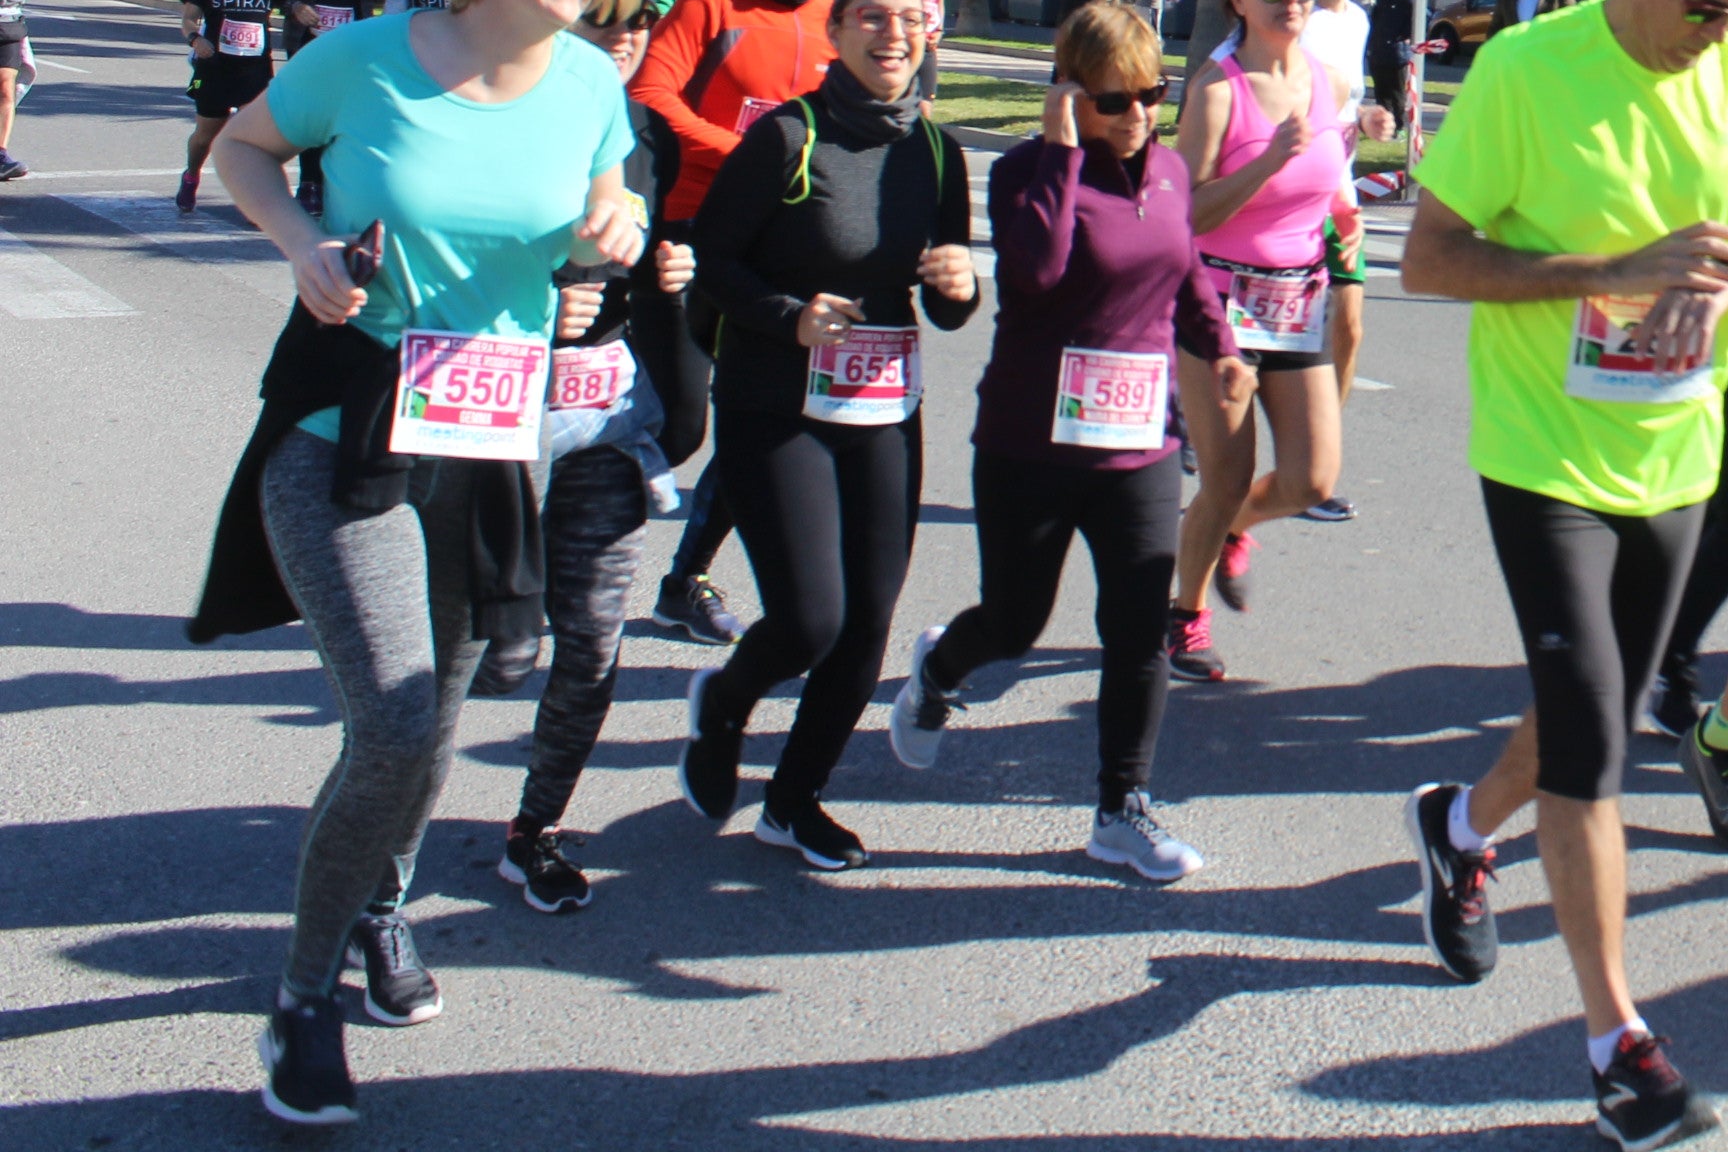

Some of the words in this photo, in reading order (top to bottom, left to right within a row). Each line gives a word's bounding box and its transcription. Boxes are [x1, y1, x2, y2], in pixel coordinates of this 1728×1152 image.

[229, 31, 252, 42] 609
[1255, 296, 1297, 321] 579
[845, 354, 898, 383] 655
[444, 368, 514, 407] 550
[549, 374, 602, 404] 88
[1093, 380, 1145, 409] 589
